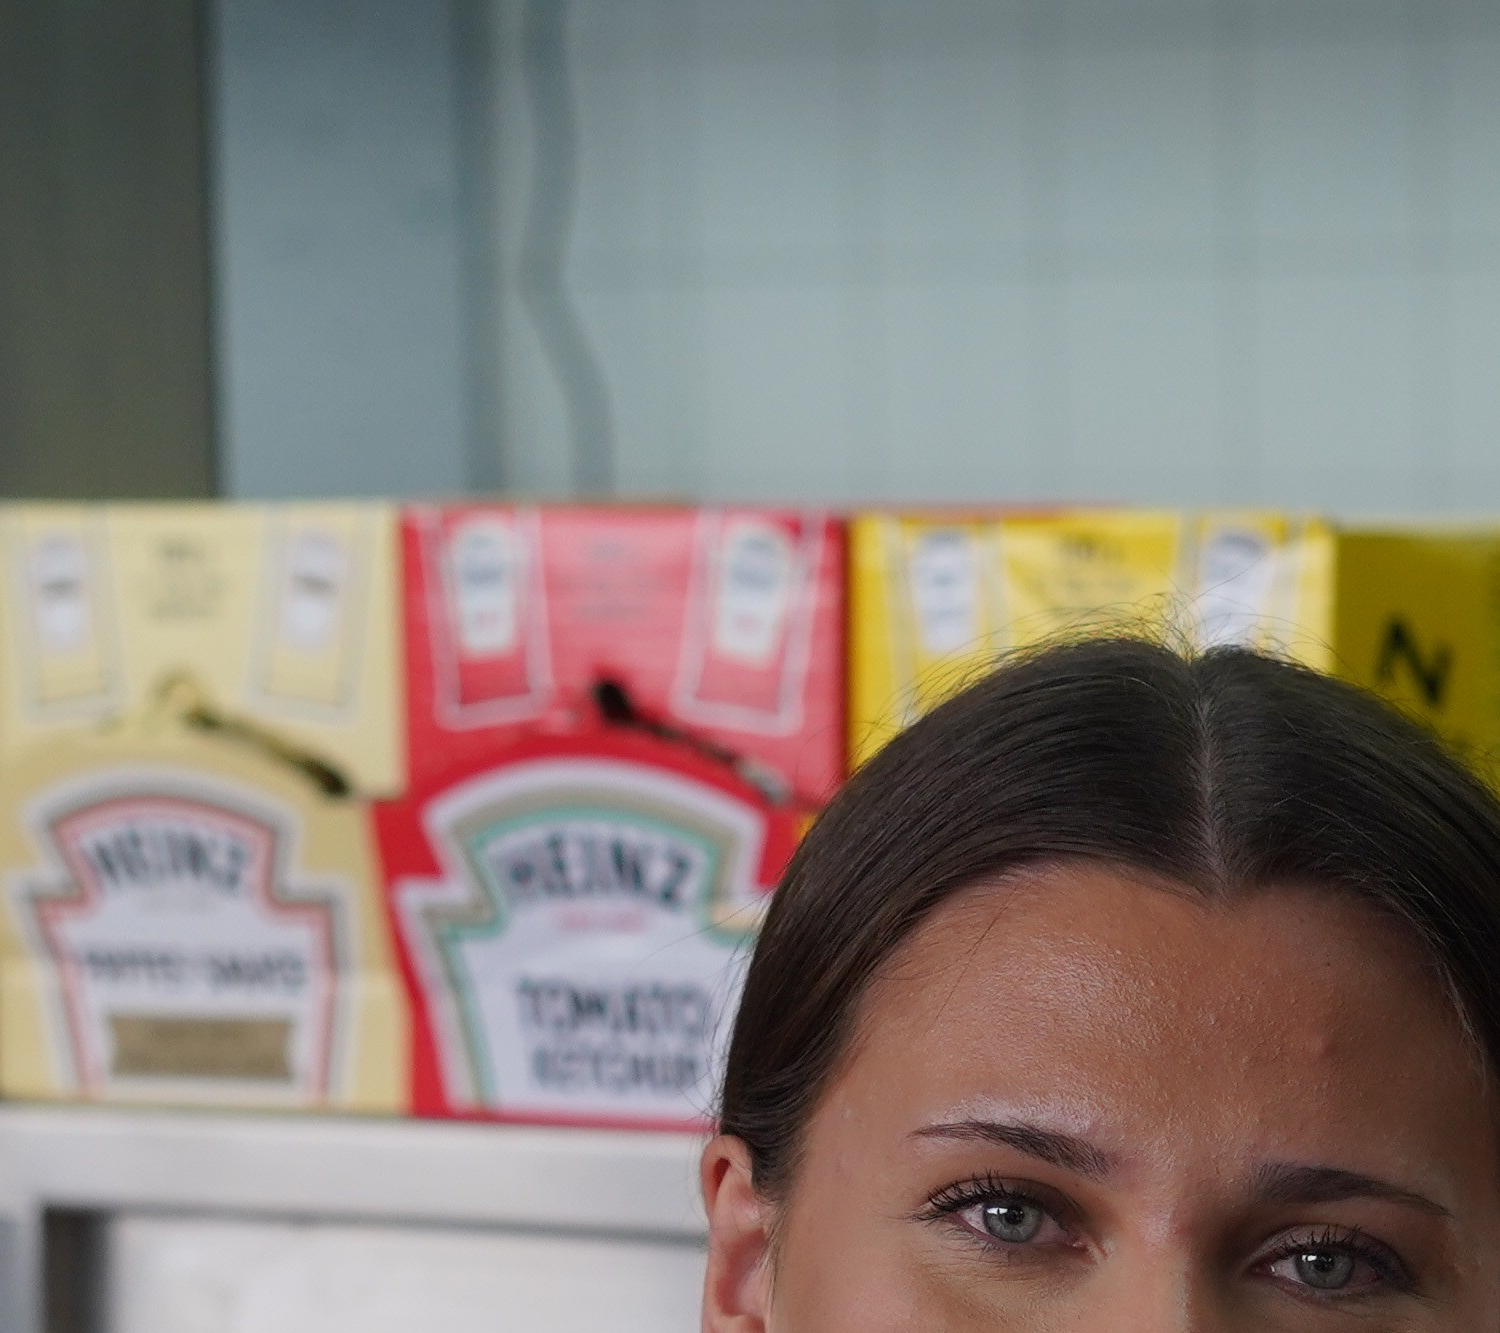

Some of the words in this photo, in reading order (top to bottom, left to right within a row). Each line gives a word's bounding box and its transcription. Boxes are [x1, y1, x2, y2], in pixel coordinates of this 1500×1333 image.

[86, 821, 253, 896] HEINZ
[495, 828, 691, 911] HEINZ
[517, 977, 713, 1039] TOMATO
[530, 1048, 701, 1094] KETCHUP
